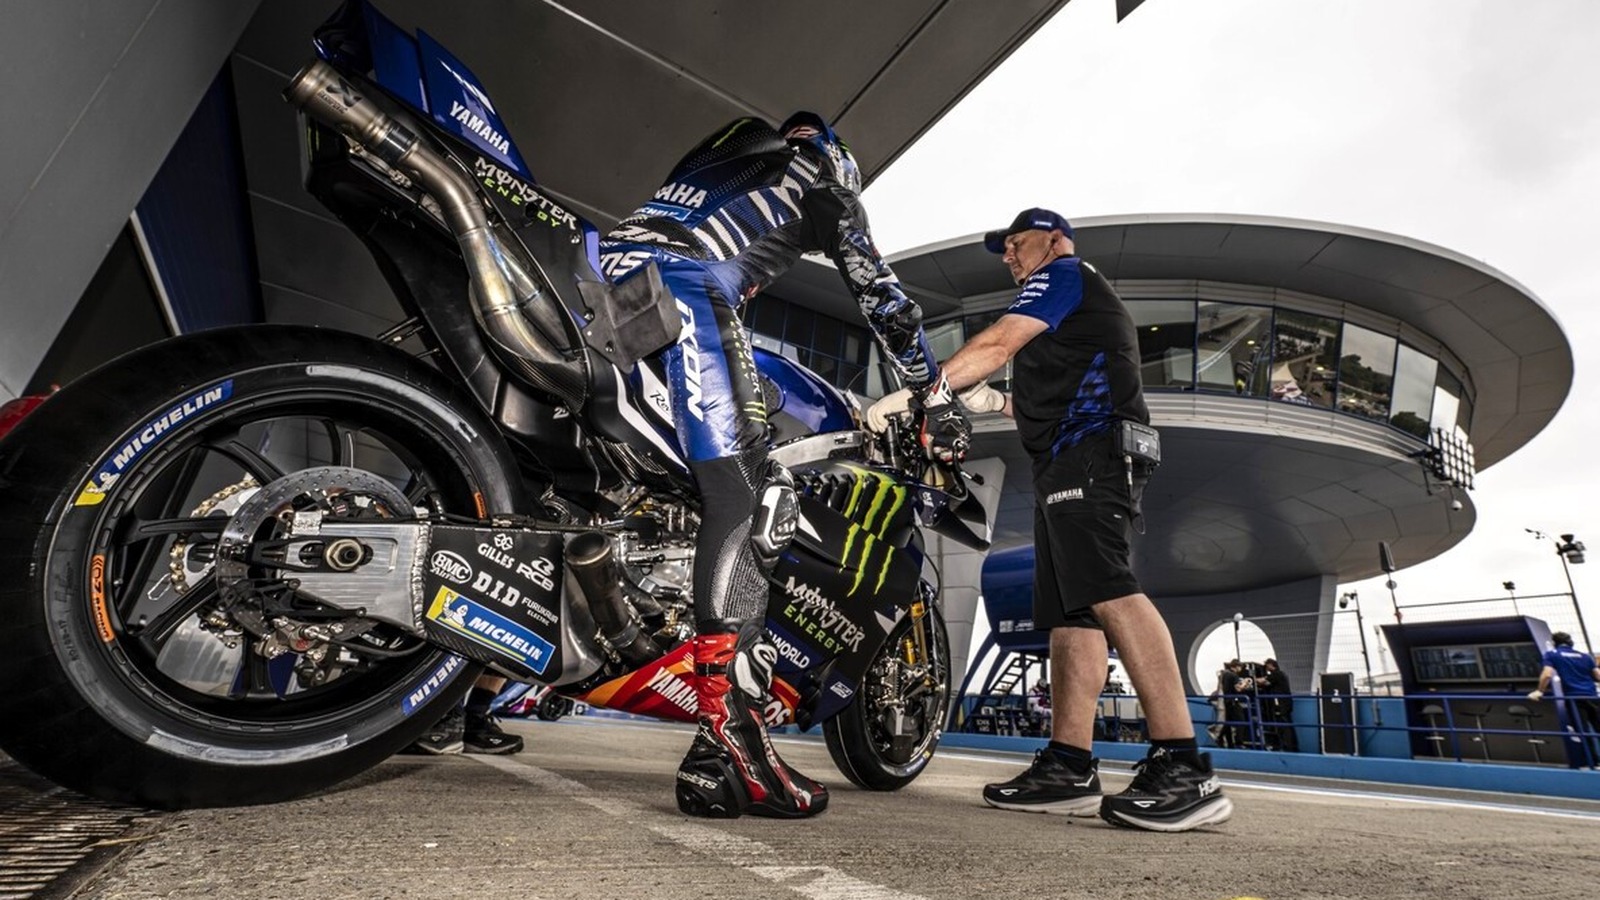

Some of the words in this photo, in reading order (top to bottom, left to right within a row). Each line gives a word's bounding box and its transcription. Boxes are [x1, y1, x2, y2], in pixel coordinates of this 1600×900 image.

[450, 101, 508, 155] YAMAHA
[475, 156, 578, 230] MONSTER
[484, 178, 561, 228] ENEGY
[675, 298, 704, 422] IXON
[113, 387, 222, 470] MICHELIN
[1053, 488, 1084, 501] YAMAHA
[434, 553, 469, 579] BMC
[477, 543, 515, 569] GILLES
[516, 562, 554, 591] RCB
[472, 571, 520, 607] D.I.D
[527, 609, 550, 626] ELECTRIC
[783, 605, 844, 654] ENERGY
[785, 576, 865, 653] MONSTER
[468, 616, 543, 660] MICHELIN
